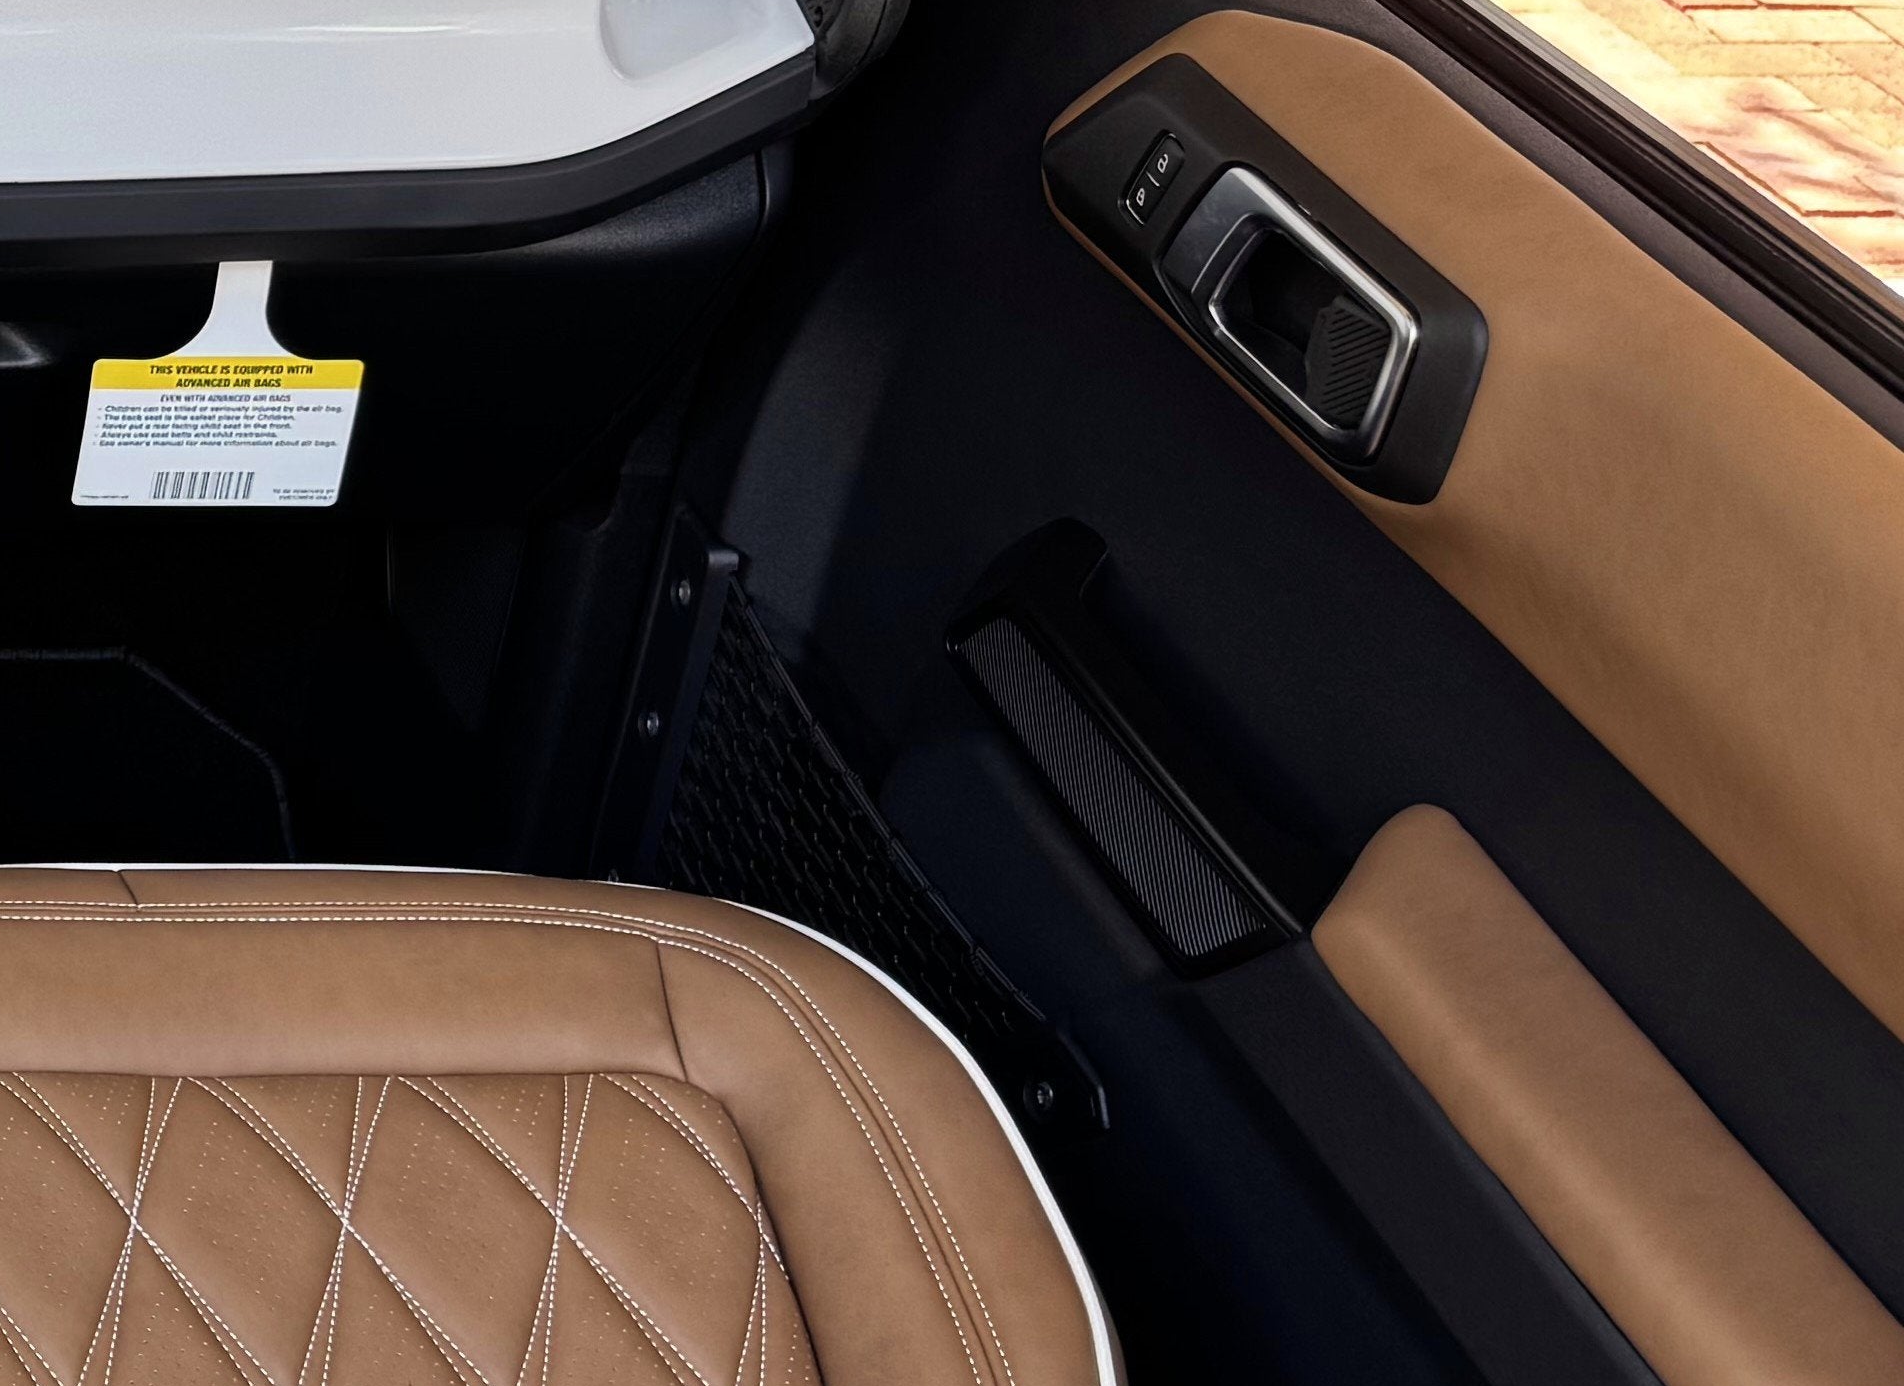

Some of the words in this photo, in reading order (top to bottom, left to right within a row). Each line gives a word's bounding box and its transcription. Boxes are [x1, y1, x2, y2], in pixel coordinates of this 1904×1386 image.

[150, 365, 174, 375] THIS
[176, 365, 218, 375] VEHICLE
[233, 365, 284, 375] EQUIPPED
[286, 365, 313, 375] WITH
[175, 378, 230, 388] ADVANCED
[233, 378, 252, 388] AIR
[254, 378, 282, 388] BAGS
[184, 394, 206, 402] WITH
[207, 394, 251, 402] ADVANCED
